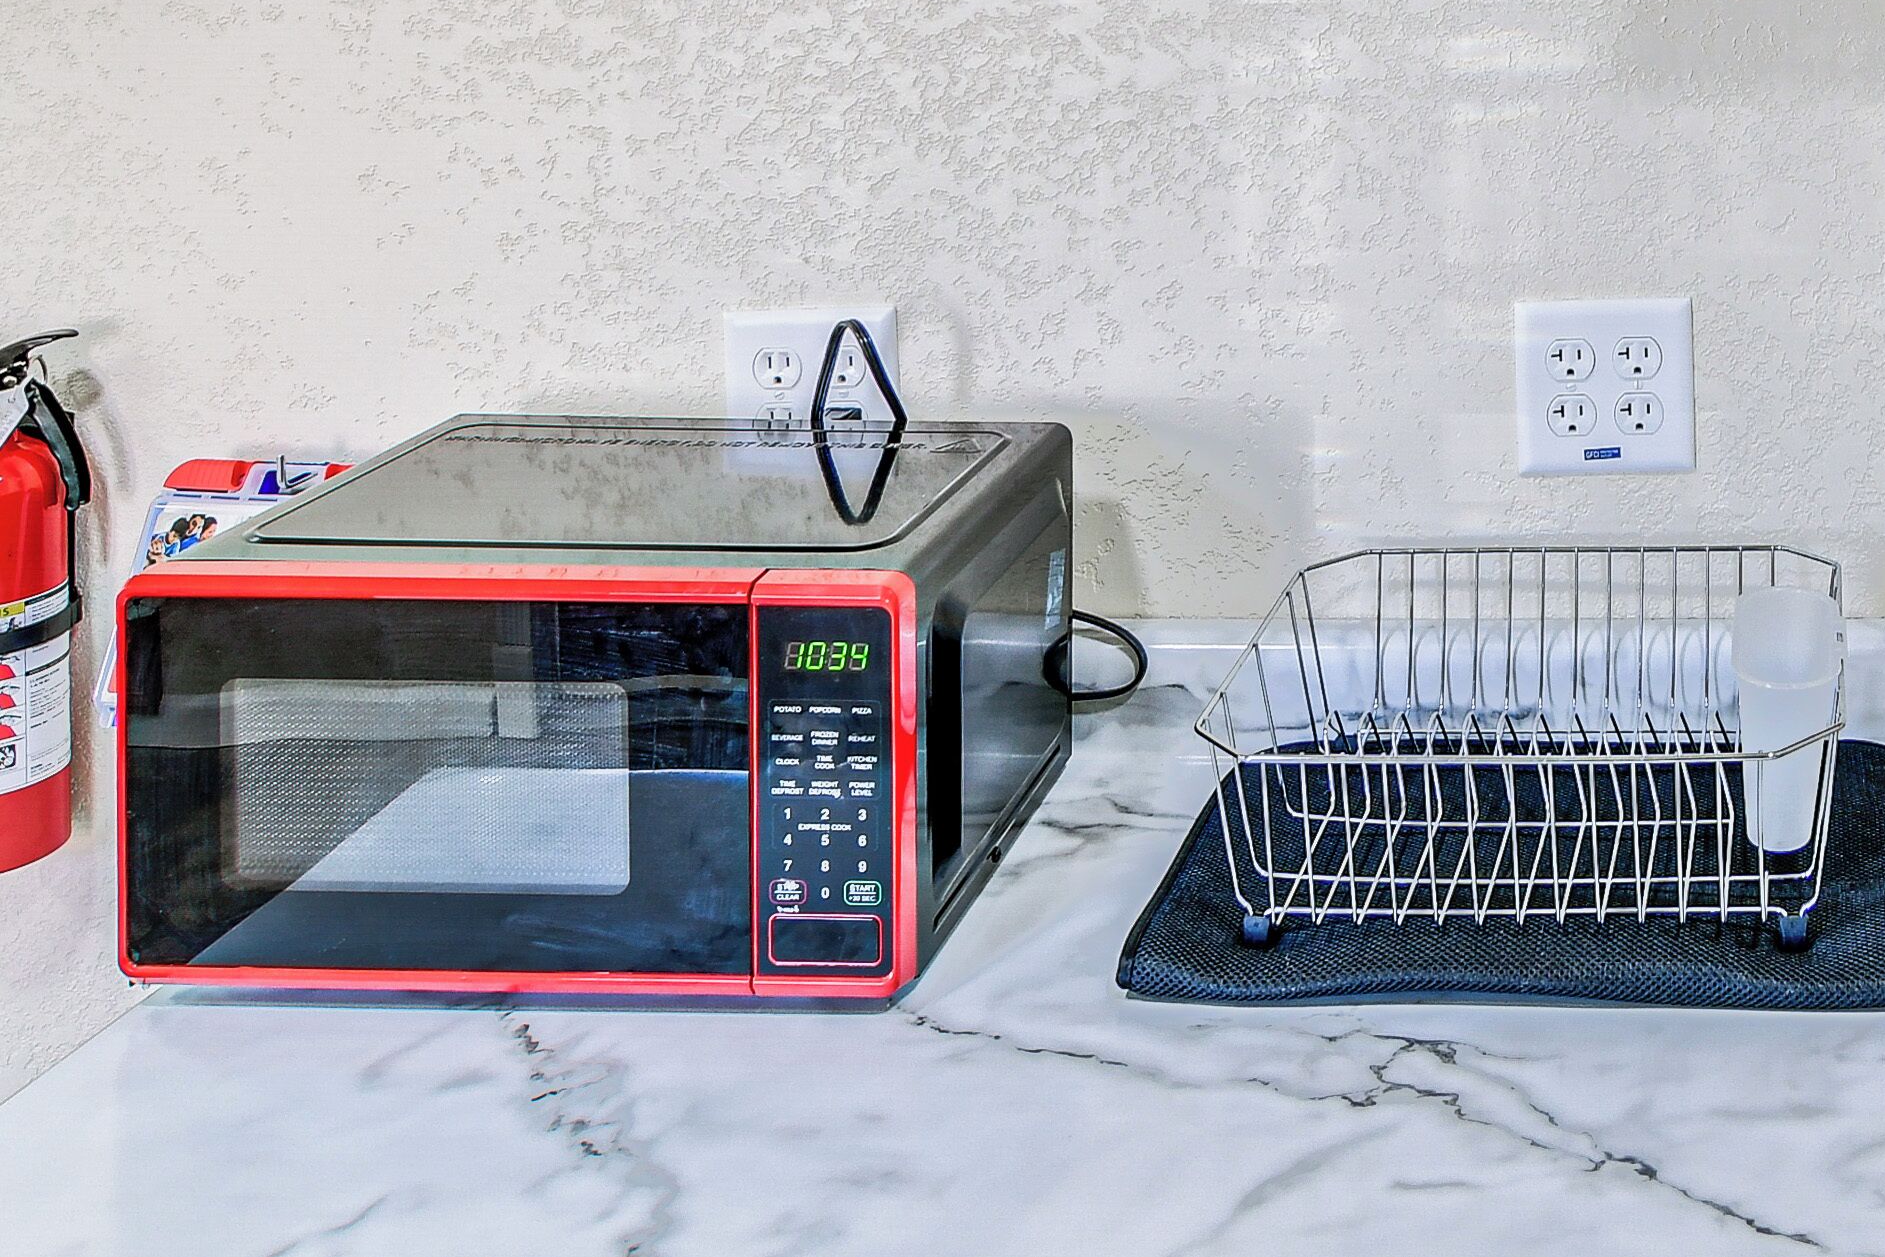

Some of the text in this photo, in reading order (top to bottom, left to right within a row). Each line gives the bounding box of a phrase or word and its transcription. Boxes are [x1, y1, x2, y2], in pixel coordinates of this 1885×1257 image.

[797, 641, 869, 670] 1034
[773, 706, 802, 714] POTATO
[809, 706, 842, 714] POPCORN
[851, 707, 873, 715] PIZZA
[771, 734, 804, 742] BEVERAGE
[810, 731, 840, 739] FROZEN
[847, 735, 876, 743] REHEAT
[775, 758, 800, 766] CLOCK
[816, 755, 834, 763] TIME
[847, 756, 878, 764] KITCHEN
[814, 762, 836, 770] COOK
[851, 763, 873, 771] TIMER
[779, 780, 796, 788] TIME
[811, 781, 839, 789] WEIGHT
[848, 782, 876, 790] POWER
[771, 787, 804, 795] DEFROST
[851, 789, 873, 797] LEVEL
[783, 807, 792, 820] 1
[820, 808, 830, 820] 2
[858, 809, 868, 821] 3
[797, 823, 830, 831] EXPRESS
[783, 834, 792, 846] 4
[820, 834, 830, 846] 5
[858, 835, 868, 847] 6
[783, 859, 793, 872] 7
[820, 860, 830, 872] 8
[858, 861, 868, 873] 9
[849, 884, 876, 893] START
[776, 893, 800, 901] CLEAR
[820, 887, 830, 900] 0
